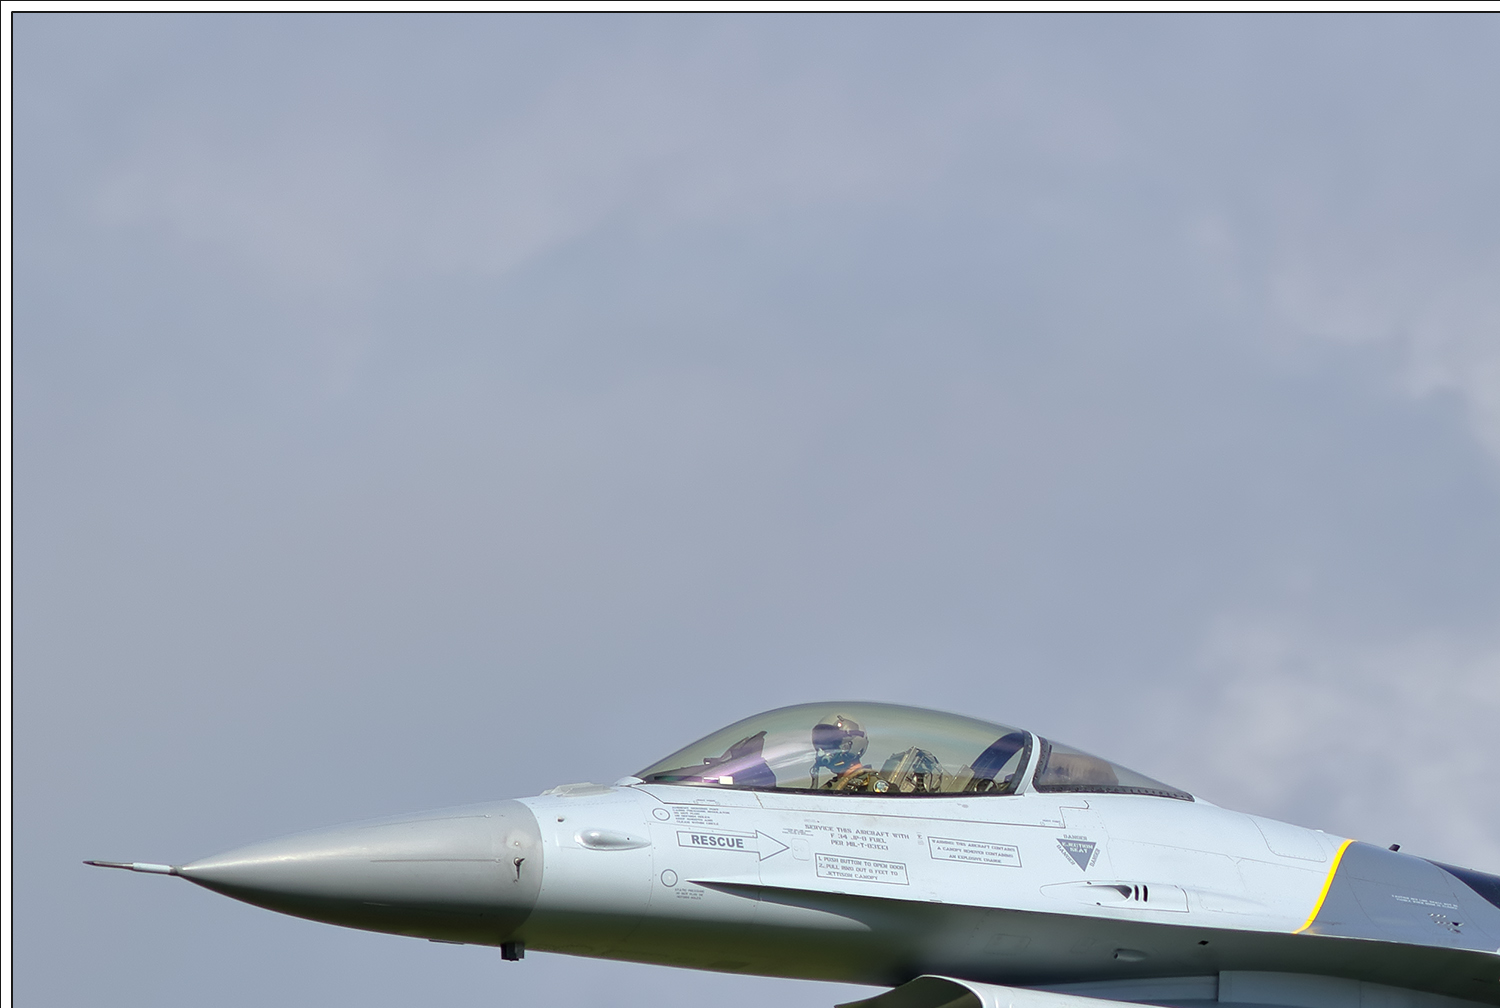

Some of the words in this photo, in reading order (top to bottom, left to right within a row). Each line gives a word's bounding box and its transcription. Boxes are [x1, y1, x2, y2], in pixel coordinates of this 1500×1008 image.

[804, 824, 834, 832] SERVICE
[855, 829, 890, 838] AIRCRAFT
[691, 834, 744, 849] RESCUE
[840, 858, 862, 866] BUTTON
